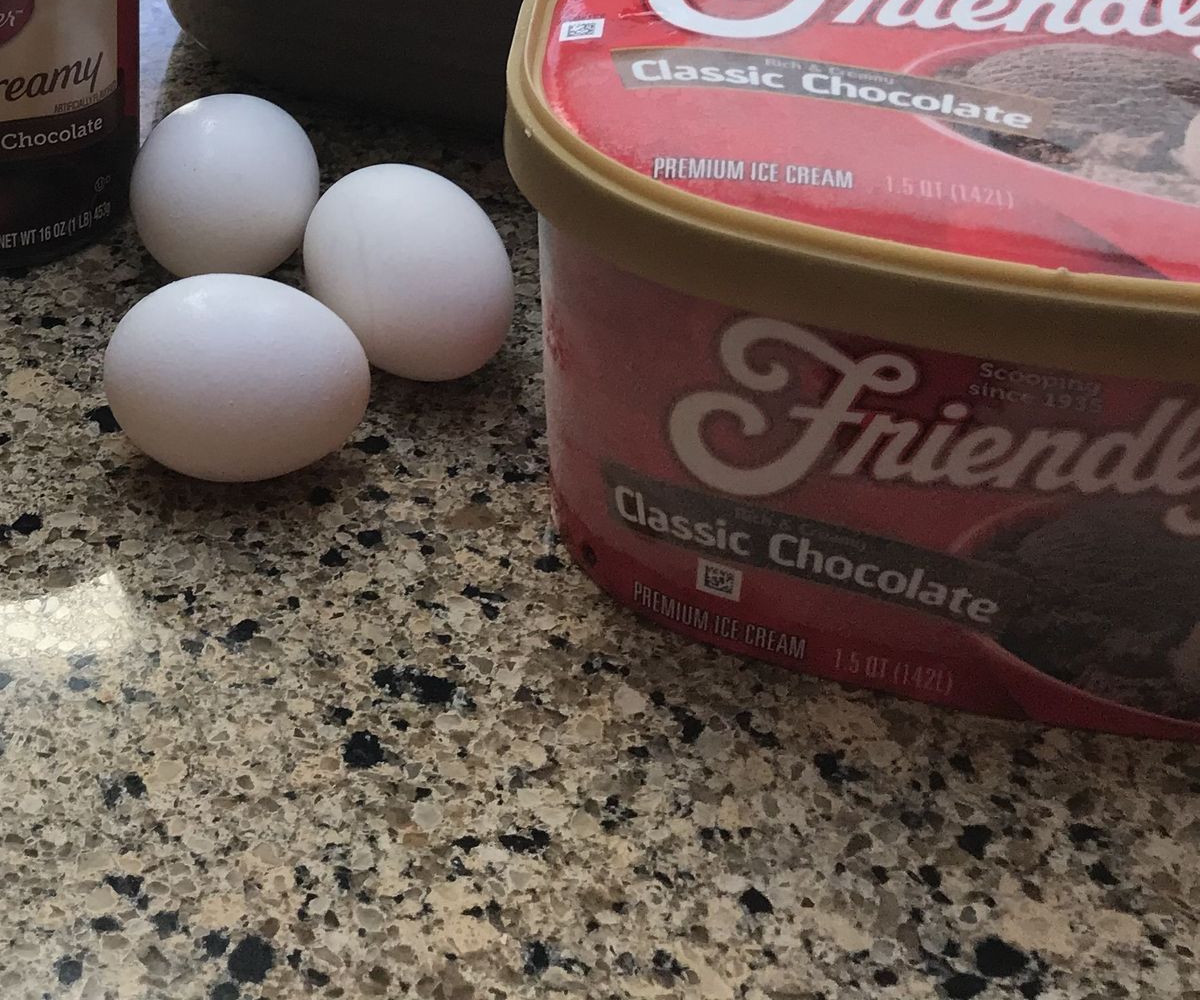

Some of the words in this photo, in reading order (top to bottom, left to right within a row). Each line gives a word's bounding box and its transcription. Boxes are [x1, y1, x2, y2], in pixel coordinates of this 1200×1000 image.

[630, 58, 785, 90] Classic
[800, 71, 1033, 130] Chocolate
[0, 116, 103, 151] Chocolate
[653, 156, 744, 181] PREMIUM
[751, 161, 779, 183] ICE
[785, 164, 855, 190] CREAM
[20, 229, 37, 246] WT
[39, 225, 52, 243] 16
[53, 221, 66, 238] OZ
[78, 210, 92, 229] LB)
[614, 484, 751, 557] Classic
[768, 532, 1000, 626] Chocolate
[634, 580, 709, 632] PREMIUM
[715, 614, 740, 642] ICE
[744, 623, 807, 660] CREAM
